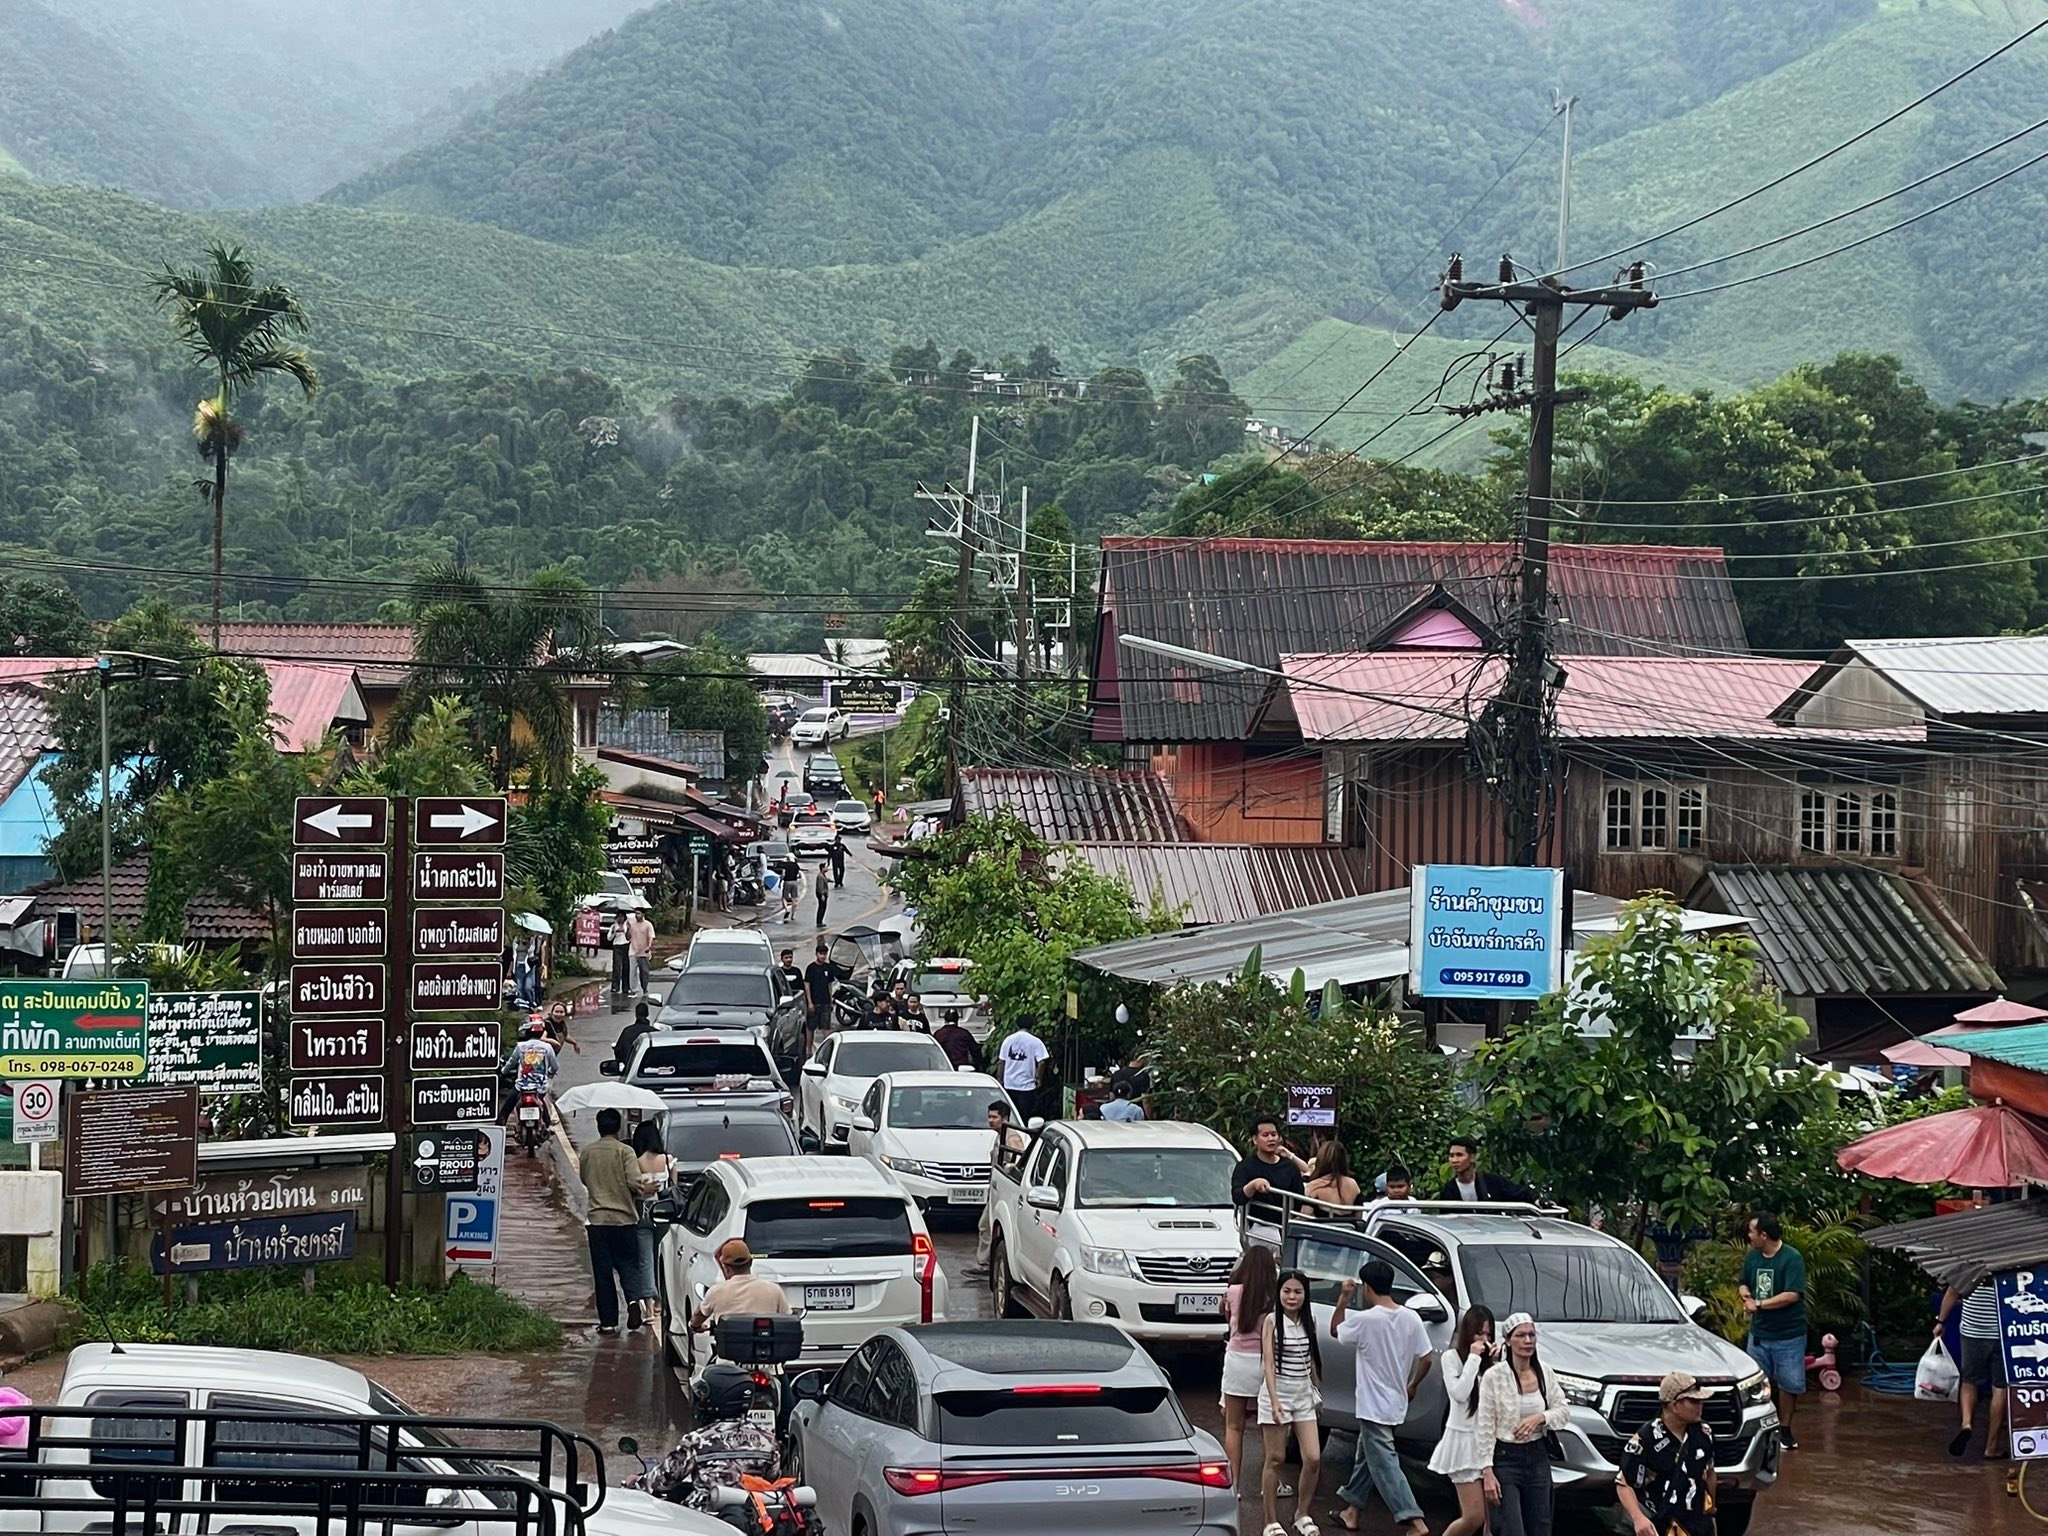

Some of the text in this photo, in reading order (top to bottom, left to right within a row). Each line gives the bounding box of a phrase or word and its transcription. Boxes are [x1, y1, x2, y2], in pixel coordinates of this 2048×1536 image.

[419, 855, 497, 888] น้ำตกสะปัน
[318, 879, 364, 898] ฟาร์มสเตย์
[1429, 886, 1544, 920] ร้านค้าชุมชน
[297, 926, 345, 945] สายหมอก
[1429, 927, 1545, 951] บัวจันทร์การค้า
[1453, 971, 1525, 984] 095 917 6918
[1, 985, 145, 1009] ณ สะปันแคมป์ปิ้ง 2
[2, 1011, 141, 1050] ที่พัก ลานกางเต็นท์
[302, 1027, 368, 1057] ไทรวารี
[8, 1059, 135, 1073] โทร. 098-067-0248
[25, 1091, 47, 1110] 30
[418, 1084, 491, 1105] กระซิบหมอก
[1311, 1095, 1321, 1108] 2
[439, 1160, 475, 1170] PROUD
[183, 1174, 317, 1217] บ้านห้วยโทน
[341, 1187, 364, 1203] กม.
[476, 1178, 496, 1197] ูผึ้ง
[2016, 1271, 2034, 1292] P
[828, 1287, 852, 1298] 9819
[2013, 1365, 2036, 1378] โทร.
[2016, 1388, 2048, 1408] จุด
[1055, 1484, 1101, 1495] BYD
